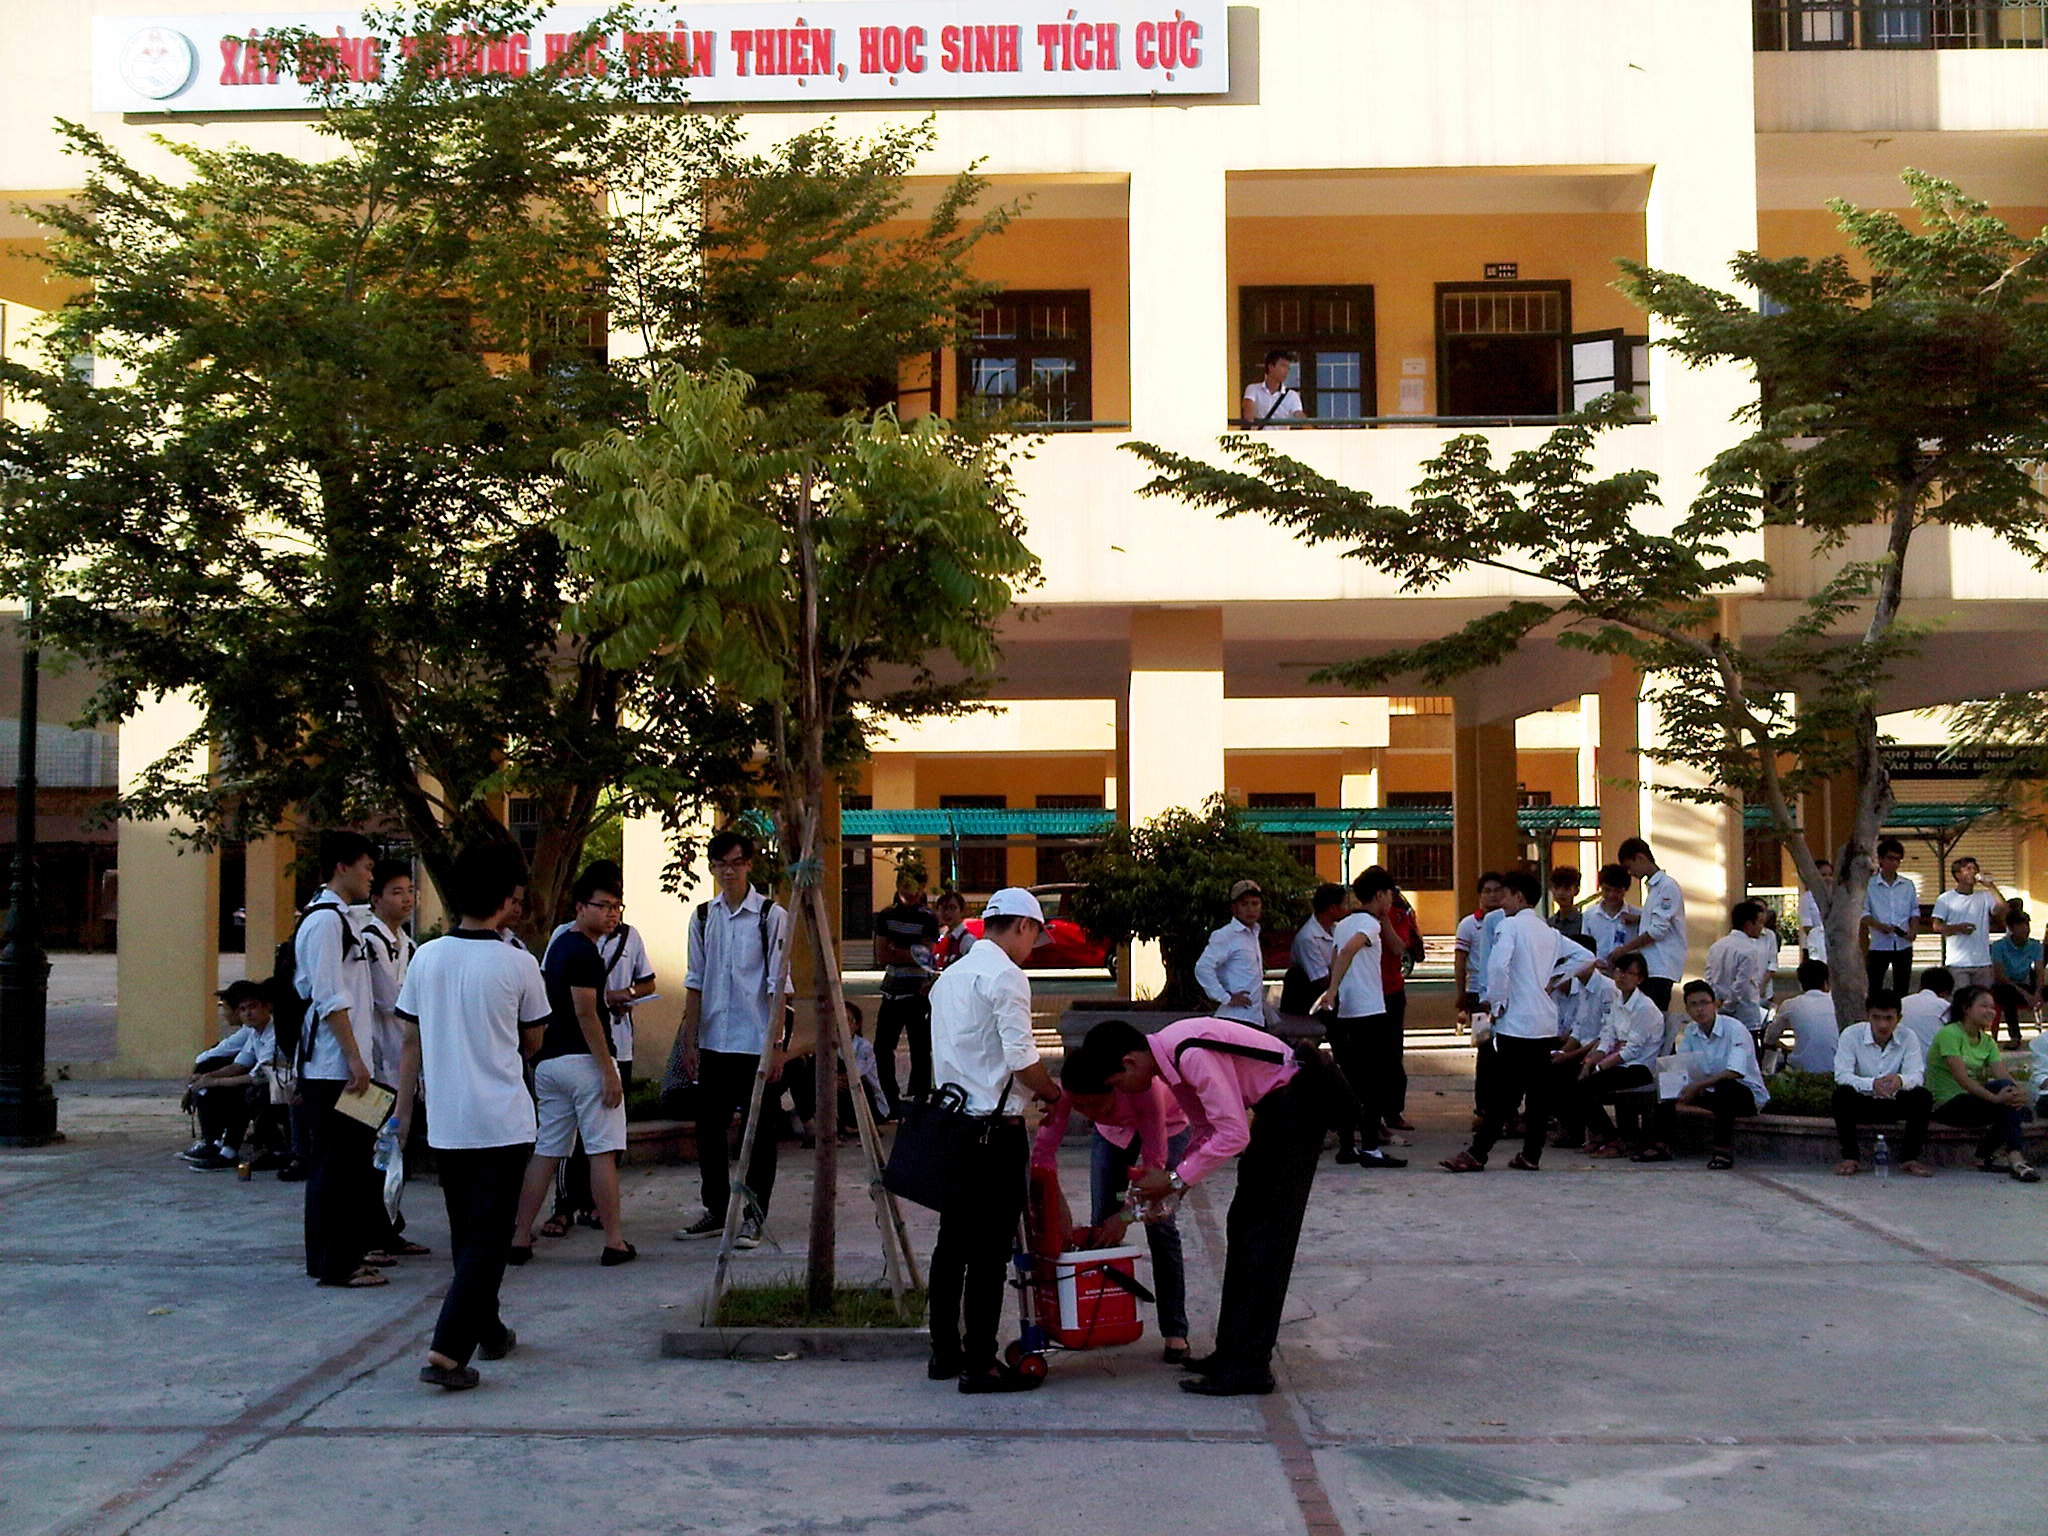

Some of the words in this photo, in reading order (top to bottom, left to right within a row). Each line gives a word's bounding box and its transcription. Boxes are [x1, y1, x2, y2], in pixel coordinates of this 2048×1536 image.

[731, 18, 845, 86] THIỆN,
[860, 26, 924, 85] HỌC
[941, 25, 1020, 73] SINH
[1037, 9, 1119, 71] TÍCH
[1136, 10, 1201, 81] CỰC
